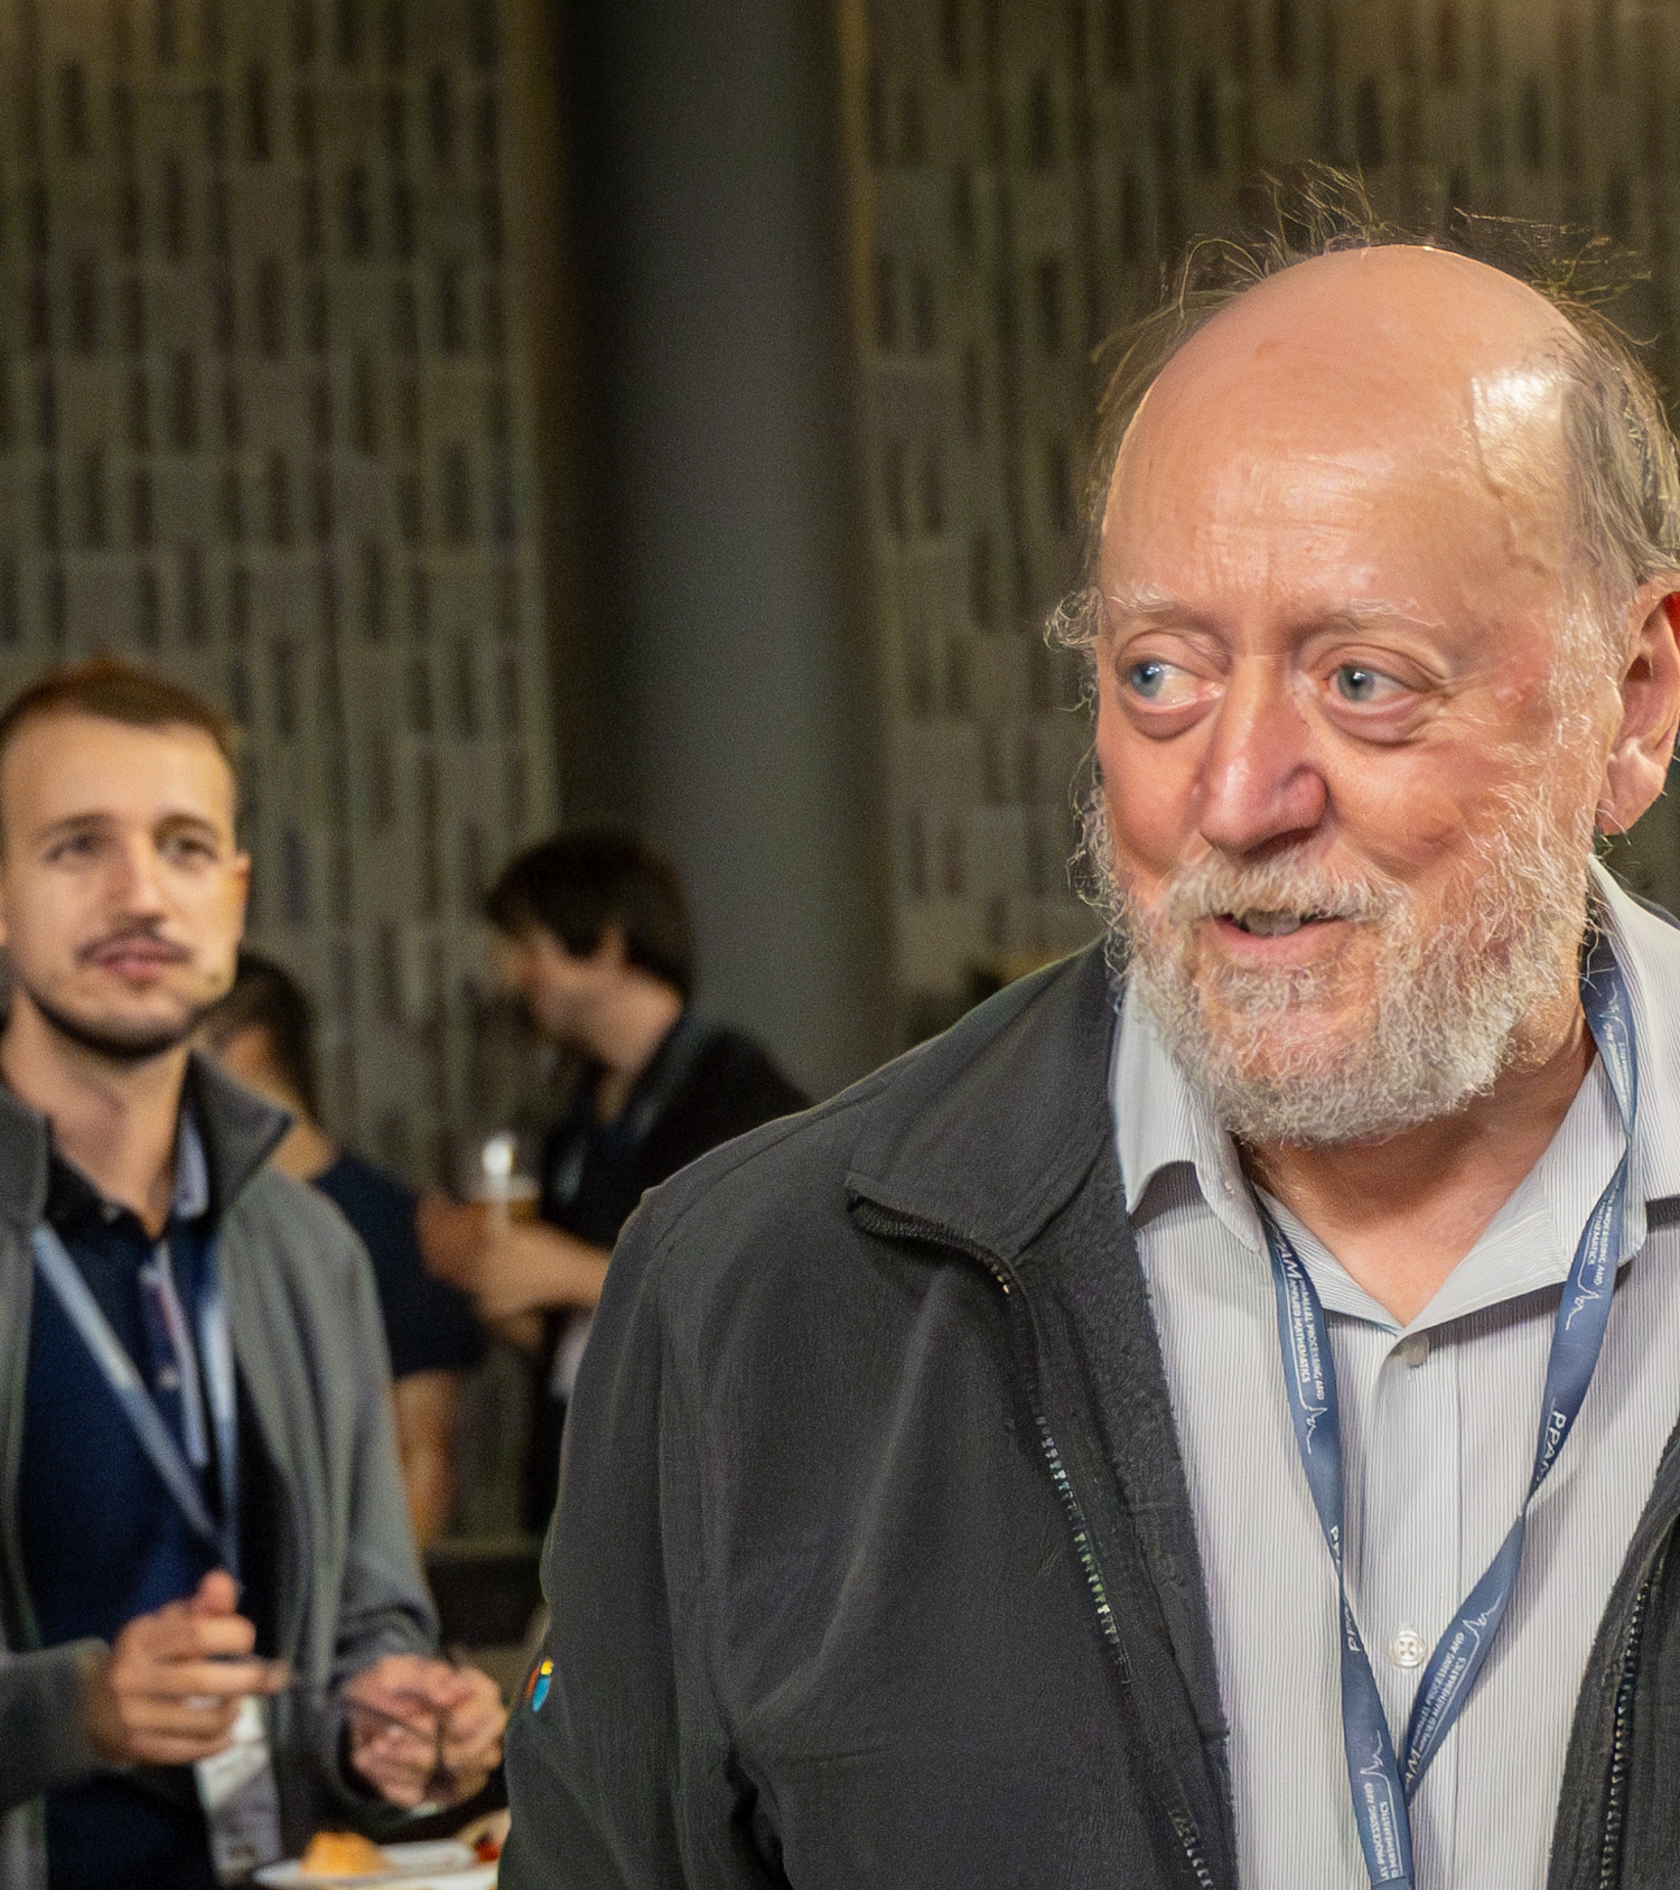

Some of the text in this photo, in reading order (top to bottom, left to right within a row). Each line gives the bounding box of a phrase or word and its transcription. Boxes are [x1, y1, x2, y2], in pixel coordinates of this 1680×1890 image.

[1593, 1264, 1604, 1286] AND
[1293, 1317, 1311, 1383] MATHEMATICS
[1305, 1321, 1322, 1380] PROCESSING
[1432, 1656, 1466, 1718] MATHEMATICS
[1365, 1782, 1384, 1865] PROCESSING AND
